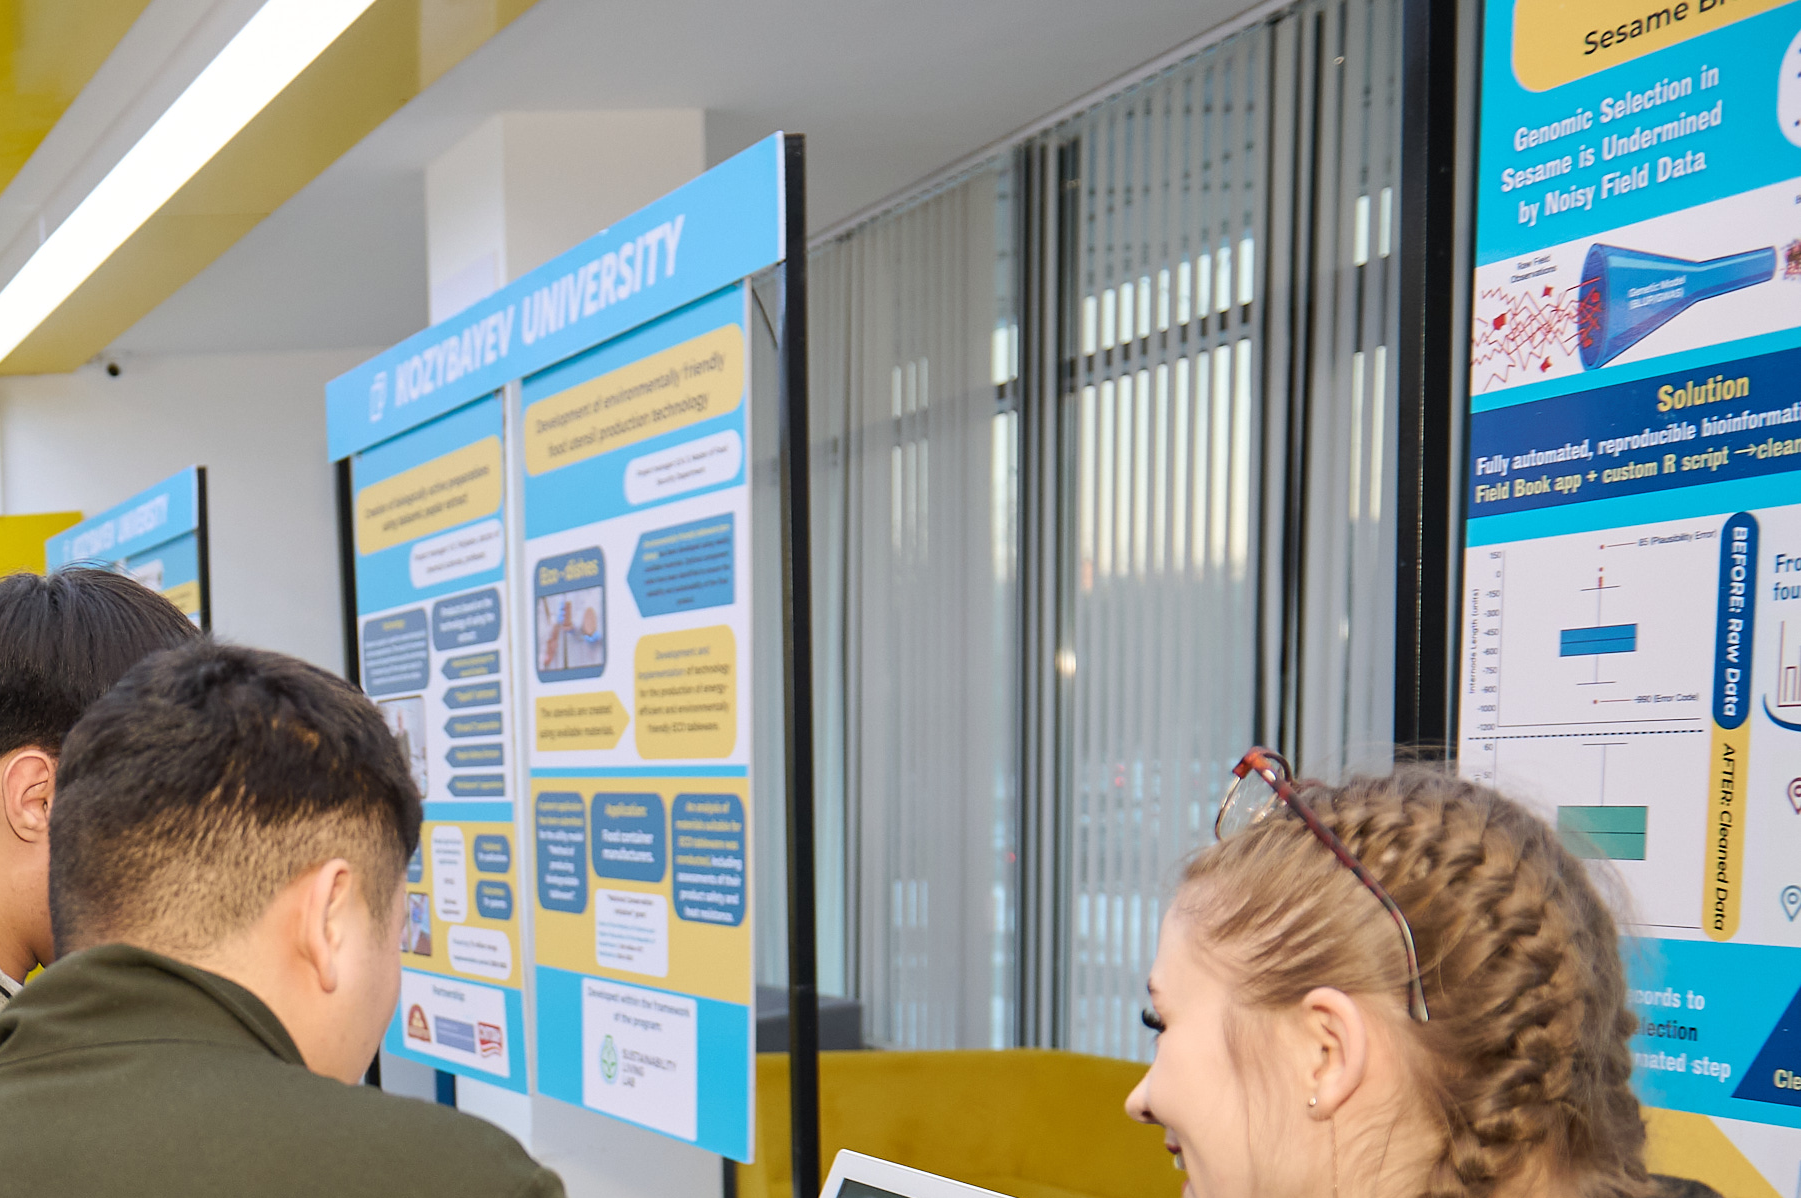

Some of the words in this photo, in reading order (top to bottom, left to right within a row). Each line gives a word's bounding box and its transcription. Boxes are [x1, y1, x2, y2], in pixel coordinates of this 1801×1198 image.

[1583, 2, 1689, 55] Sesame
[1514, 107, 1593, 152] Genomic
[1599, 78, 1693, 123] Selection
[1699, 64, 1719, 90] in
[1501, 154, 1572, 193] Sesame
[1578, 144, 1595, 168] is
[1601, 99, 1723, 161] Undermined
[1518, 200, 1539, 227] by
[1544, 185, 1596, 217] Noisy
[1600, 162, 1649, 200] Field
[1656, 150, 1707, 183] Data
[395, 304, 516, 407] KOZYBAYEV
[520, 213, 686, 346] UNIVERSITY
[682, 351, 726, 380] friendly
[651, 392, 710, 424] technology
[1656, 375, 1750, 413] Solution
[1475, 455, 1510, 478] Fully
[1511, 439, 1594, 471] automated,
[1596, 421, 1697, 456] reproducible
[1475, 478, 1510, 503] Field
[1513, 475, 1551, 499] Book
[1553, 472, 1583, 495] app
[1602, 461, 1658, 484] custom
[1662, 454, 1677, 473] R
[1681, 446, 1730, 474] script
[1727, 526, 1749, 614] BEFORE:
[1725, 618, 1744, 663] Raw
[1723, 667, 1741, 717] Data
[1720, 743, 1736, 807] AFTER:
[1716, 810, 1733, 884] Cleaned
[1714, 887, 1728, 931] Data
[1686, 990, 1705, 1010] to
[1691, 1056, 1731, 1083] step
